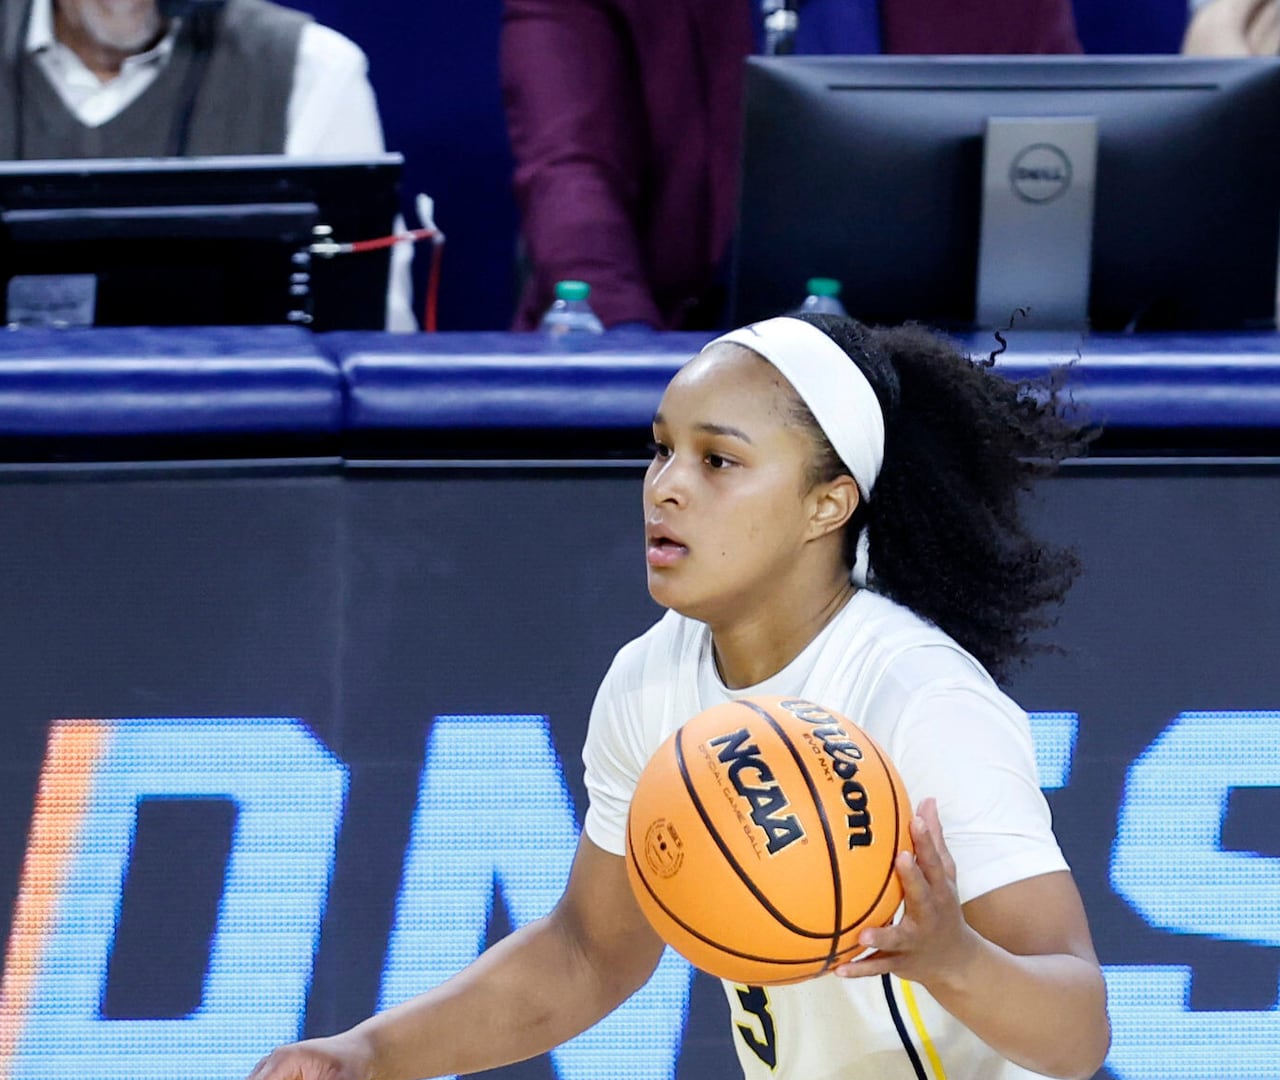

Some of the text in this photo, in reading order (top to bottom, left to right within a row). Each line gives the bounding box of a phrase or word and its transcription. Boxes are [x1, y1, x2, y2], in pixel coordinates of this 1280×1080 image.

[707, 727, 808, 857] NCAA
[779, 698, 875, 851] Wilson
[802, 732, 835, 783] EVO NXT
[722, 786, 746, 824] GAME
[743, 824, 763, 861] BALL
